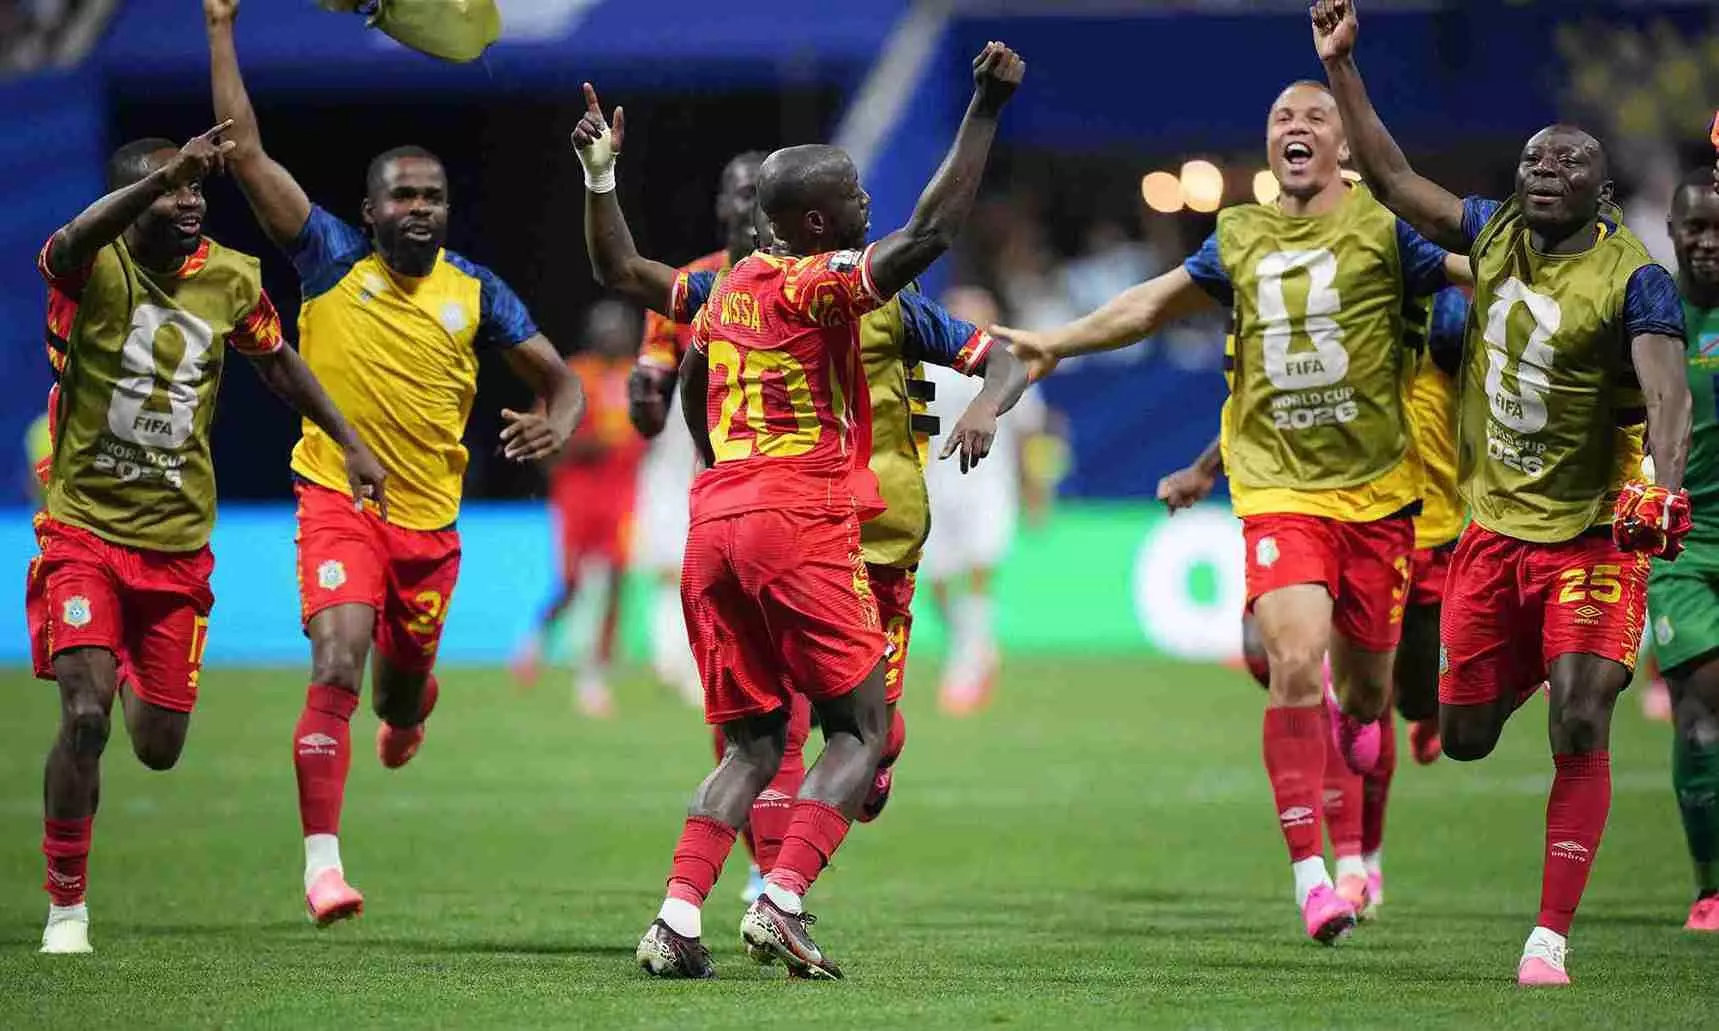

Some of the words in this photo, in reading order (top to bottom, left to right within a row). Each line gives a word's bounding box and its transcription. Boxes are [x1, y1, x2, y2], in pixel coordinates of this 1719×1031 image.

[1286, 359, 1325, 376] FIFA
[708, 340, 822, 463] 20
[1272, 392, 1322, 409] WORLD
[1323, 386, 1355, 403] CUP
[1495, 391, 1523, 420] FIFA
[132, 416, 173, 436] FIFA
[1272, 400, 1359, 430] 2026
[158, 454, 187, 467] CUP
[1559, 564, 1622, 604] 25
[1551, 851, 1586, 863] umbro
